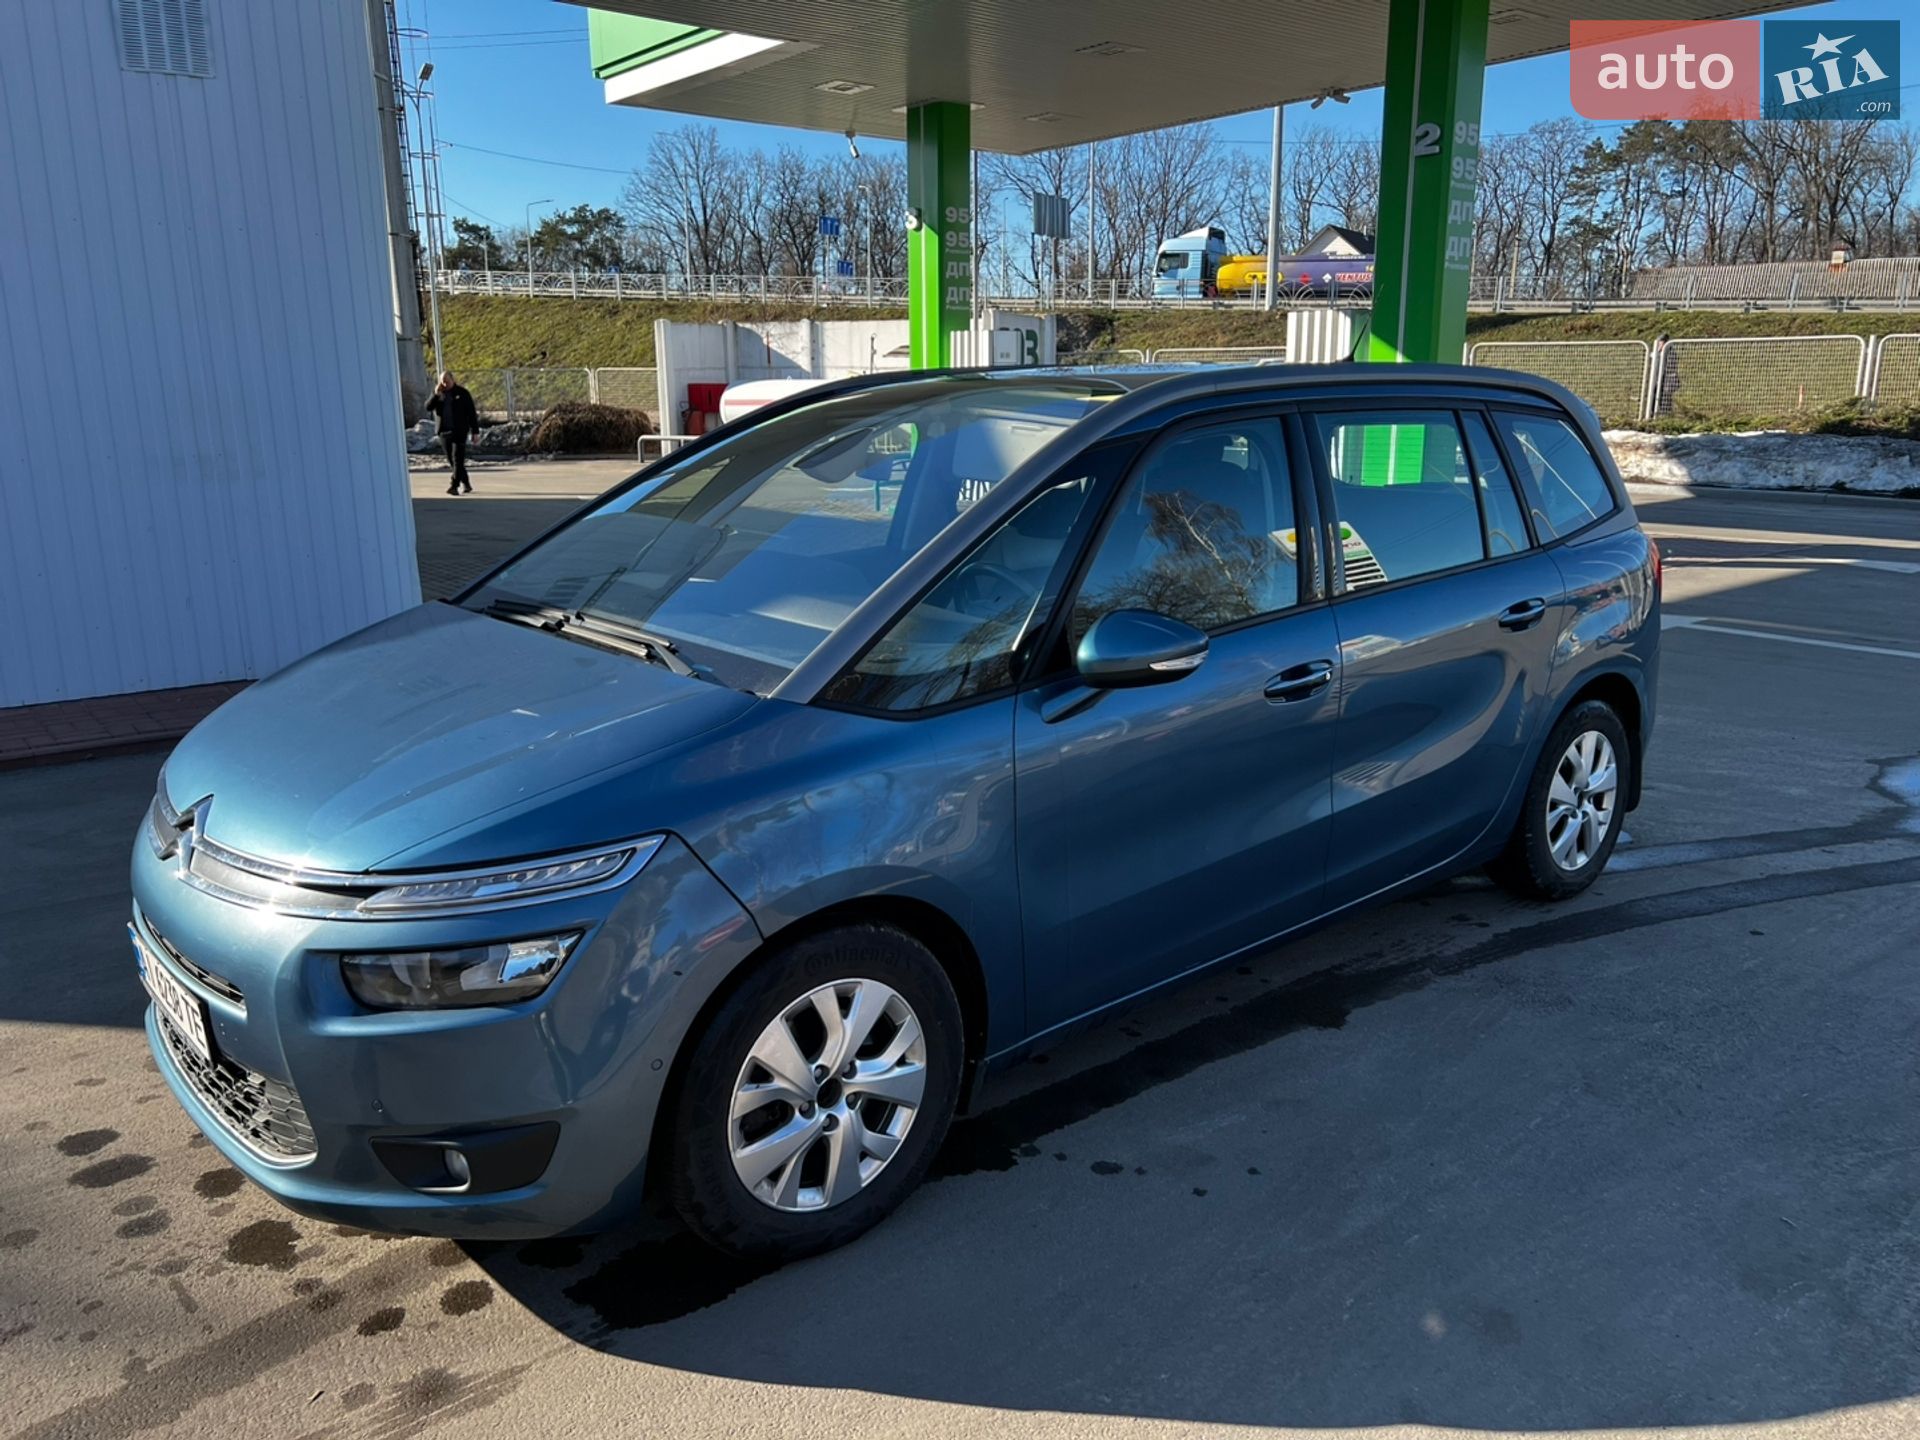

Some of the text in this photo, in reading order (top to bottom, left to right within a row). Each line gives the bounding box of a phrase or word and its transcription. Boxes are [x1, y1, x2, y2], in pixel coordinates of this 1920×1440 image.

[1415, 122, 1441, 157] 2
[1455, 120, 1479, 146] 95
[1452, 156, 1477, 181] 95
[946, 207, 970, 223] 95
[1448, 200, 1474, 225] ДП
[946, 231, 970, 248] 95
[1446, 236, 1472, 261] ДП
[946, 261, 970, 279] ДП
[946, 286, 970, 304] ДП
